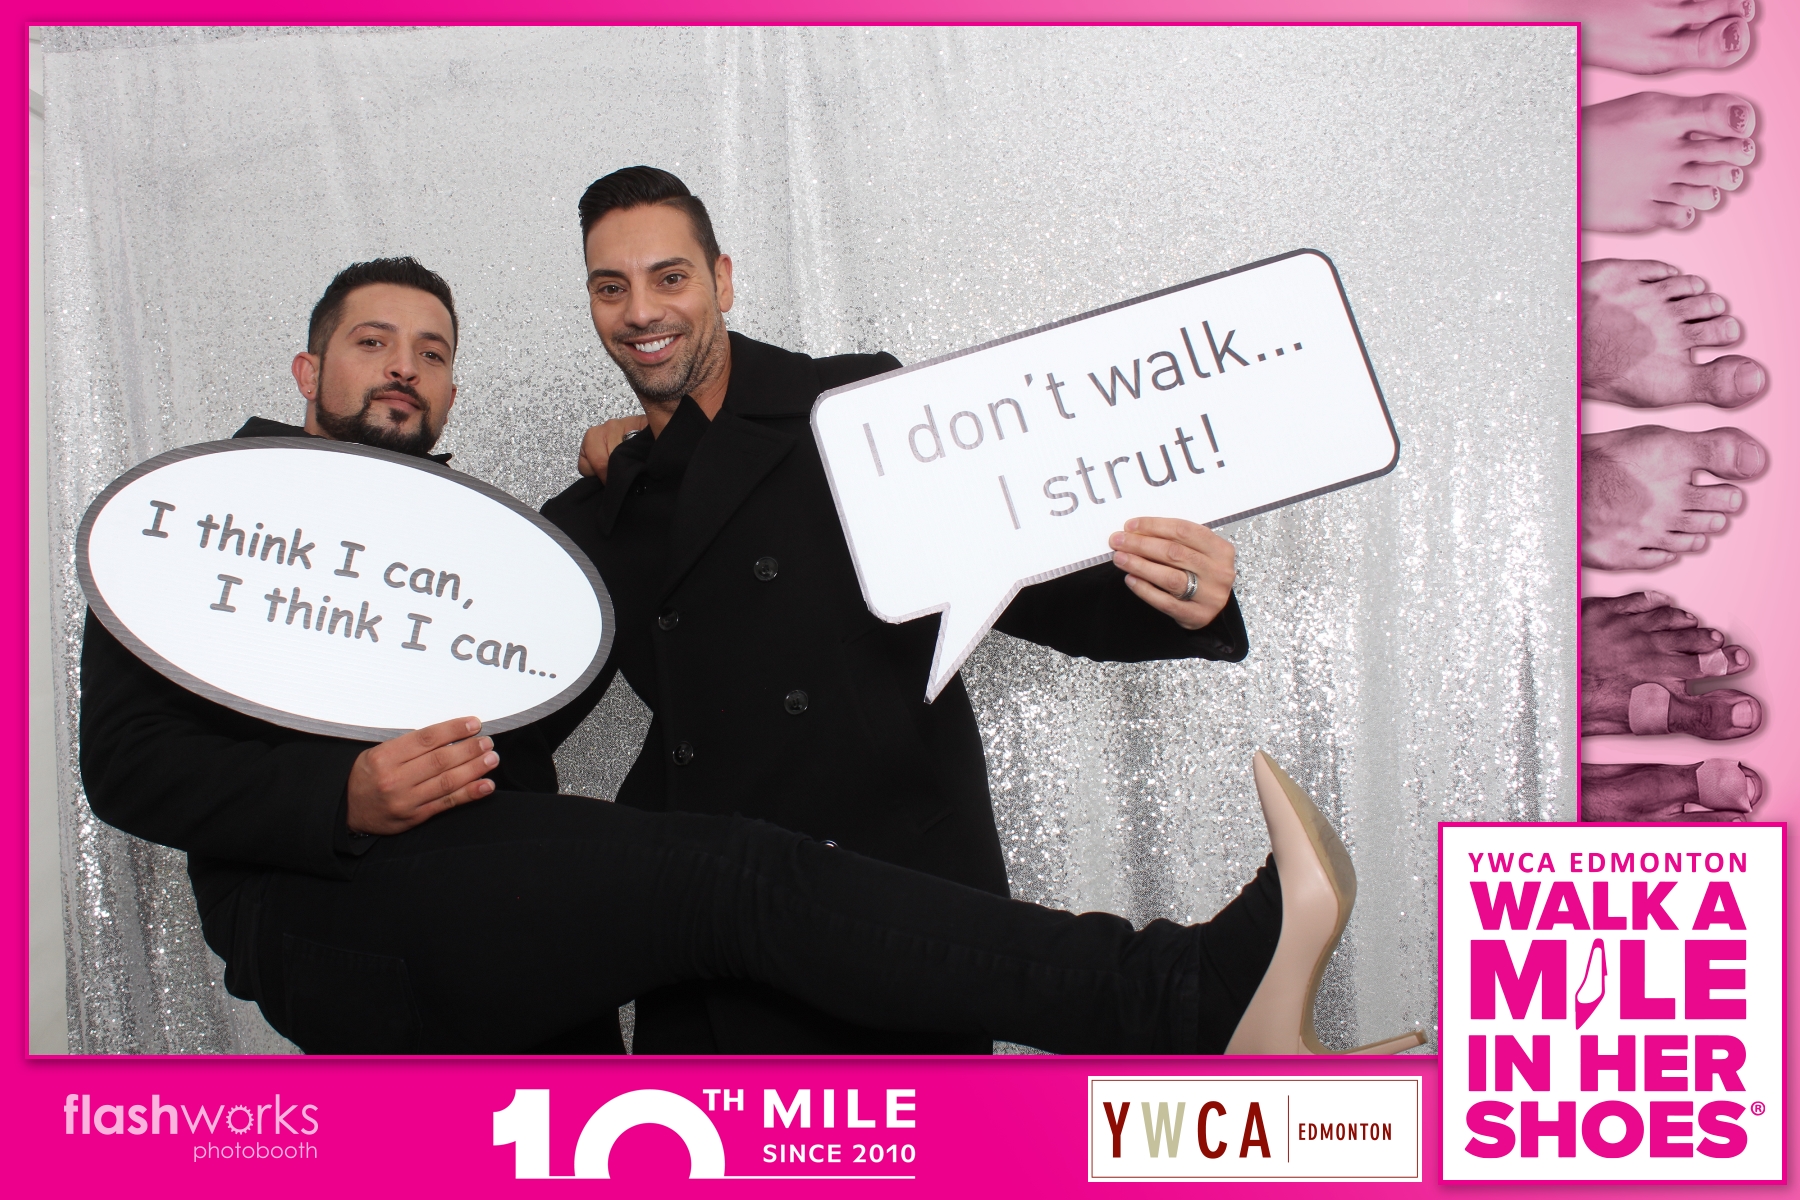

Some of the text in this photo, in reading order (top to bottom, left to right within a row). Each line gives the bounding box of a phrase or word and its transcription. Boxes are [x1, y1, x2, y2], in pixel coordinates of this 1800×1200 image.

[863, 320, 1303, 476] I don't walk...
[999, 413, 1226, 529] I strut!
[142, 500, 473, 609] I think I can,
[210, 574, 556, 679] I think I can...
